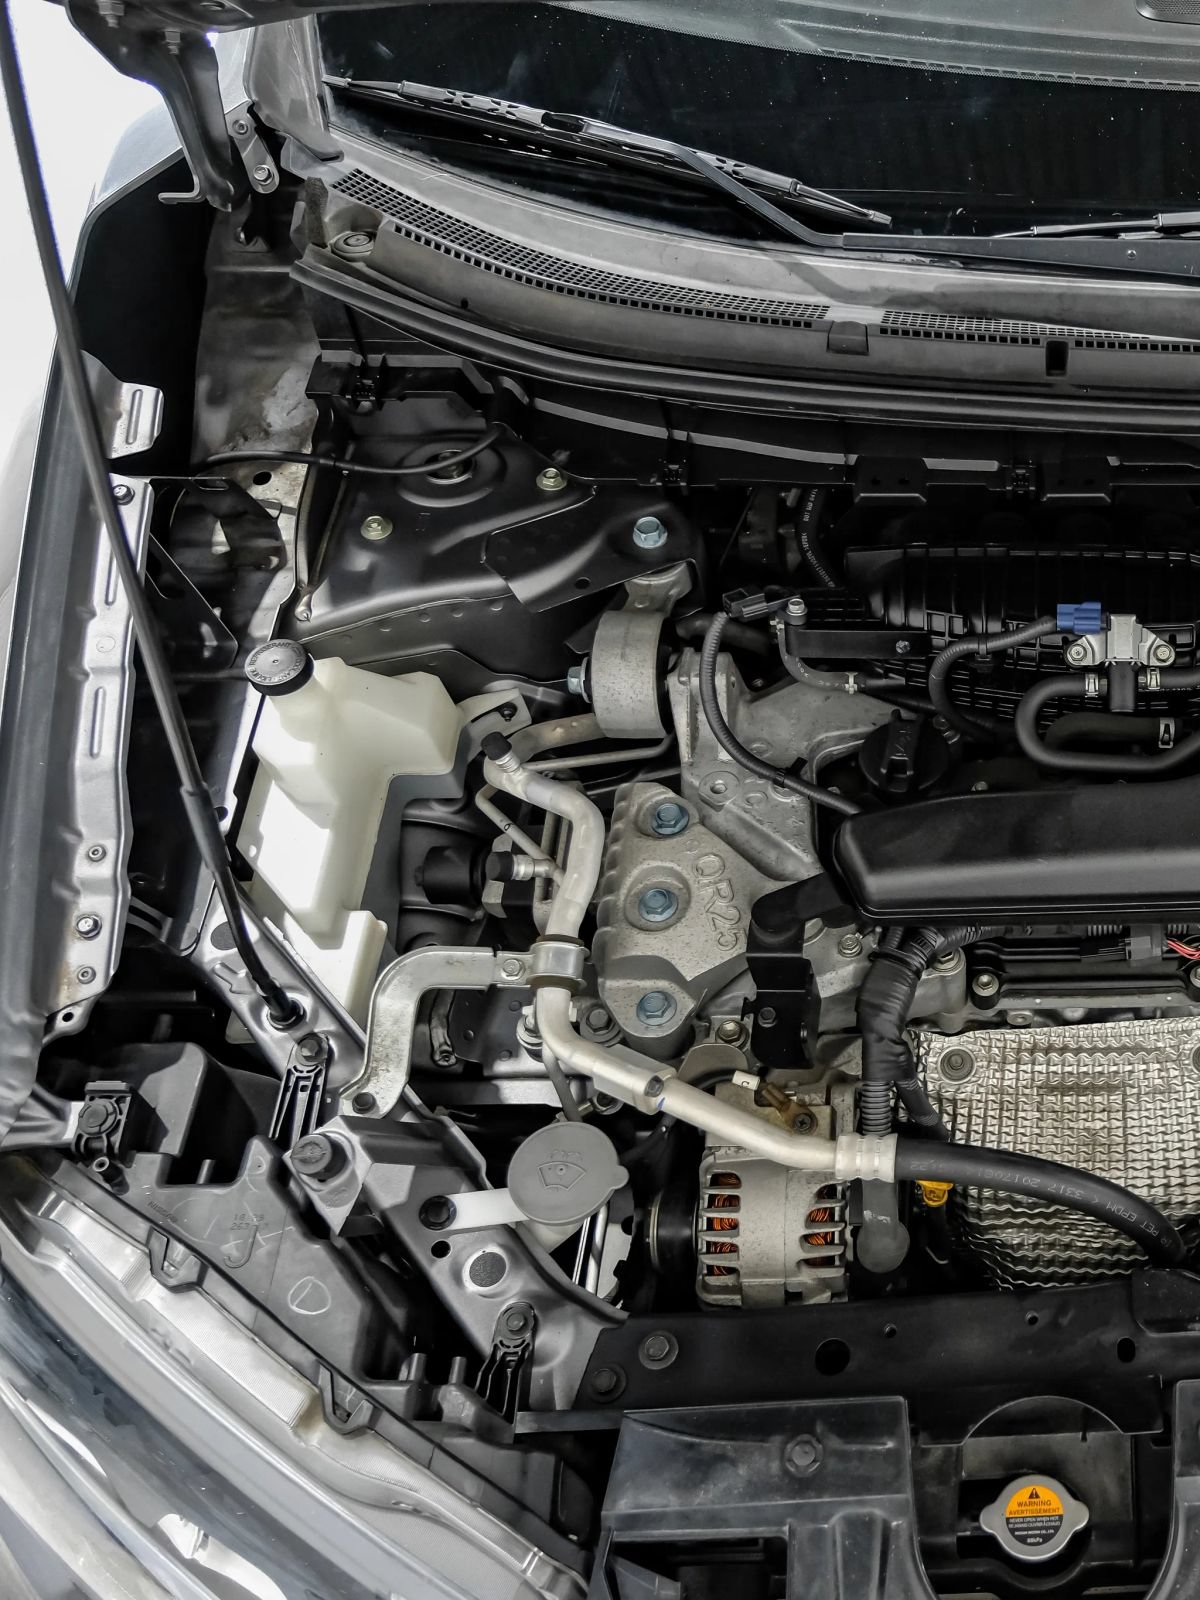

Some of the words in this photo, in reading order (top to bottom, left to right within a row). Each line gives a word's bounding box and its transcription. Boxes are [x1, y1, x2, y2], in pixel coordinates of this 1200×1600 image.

[692, 852, 747, 952] QR25
[1048, 1182, 1084, 1199] 3317
[1105, 1201, 1136, 1223] EPDM
[1139, 1220, 1159, 1237] PET
[1009, 1507, 1059, 1516] AVERTISSEMENT
